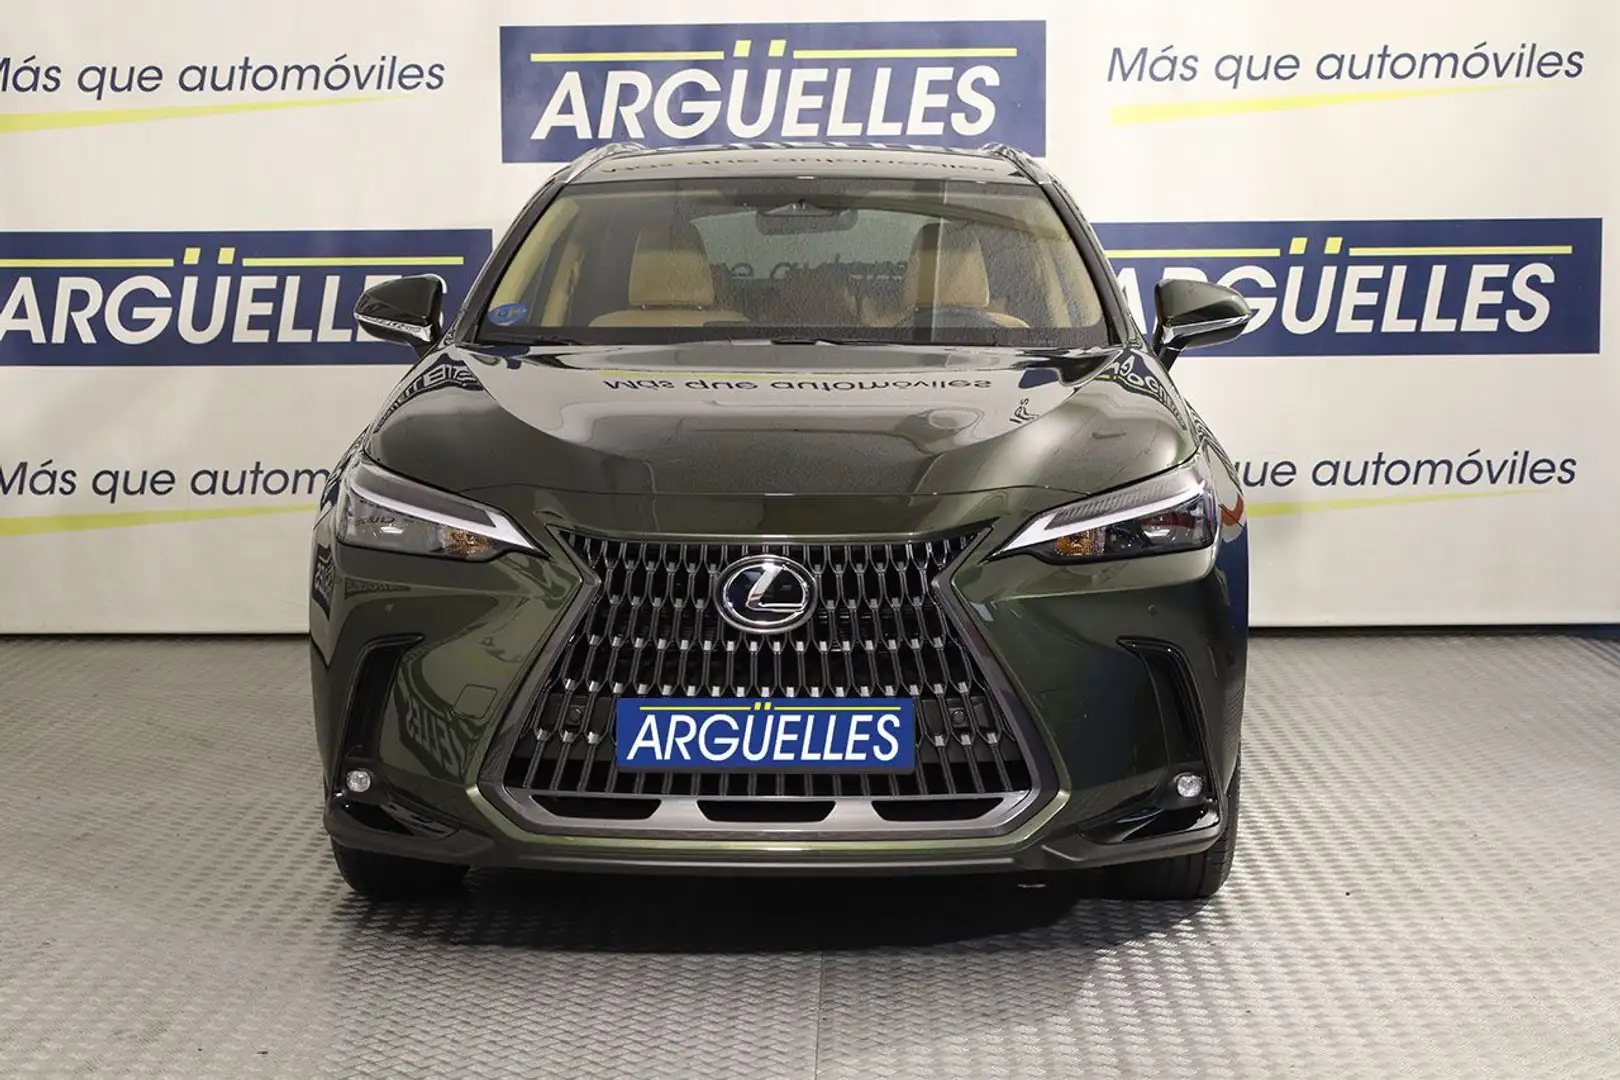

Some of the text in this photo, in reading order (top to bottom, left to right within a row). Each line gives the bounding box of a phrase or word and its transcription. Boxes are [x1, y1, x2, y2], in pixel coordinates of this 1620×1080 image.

[0, 53, 445, 101] ás que automóviles
[529, 39, 1001, 140] ARGÜELLES
[1107, 41, 1585, 90] Más que automóviles
[0, 247, 447, 345] ARGÜELL
[1117, 236, 1556, 335] AGÜELLES
[0, 458, 331, 505] Más que autom
[1234, 448, 1577, 489] ue automóviles
[626, 701, 901, 762] ARGÜELLES
